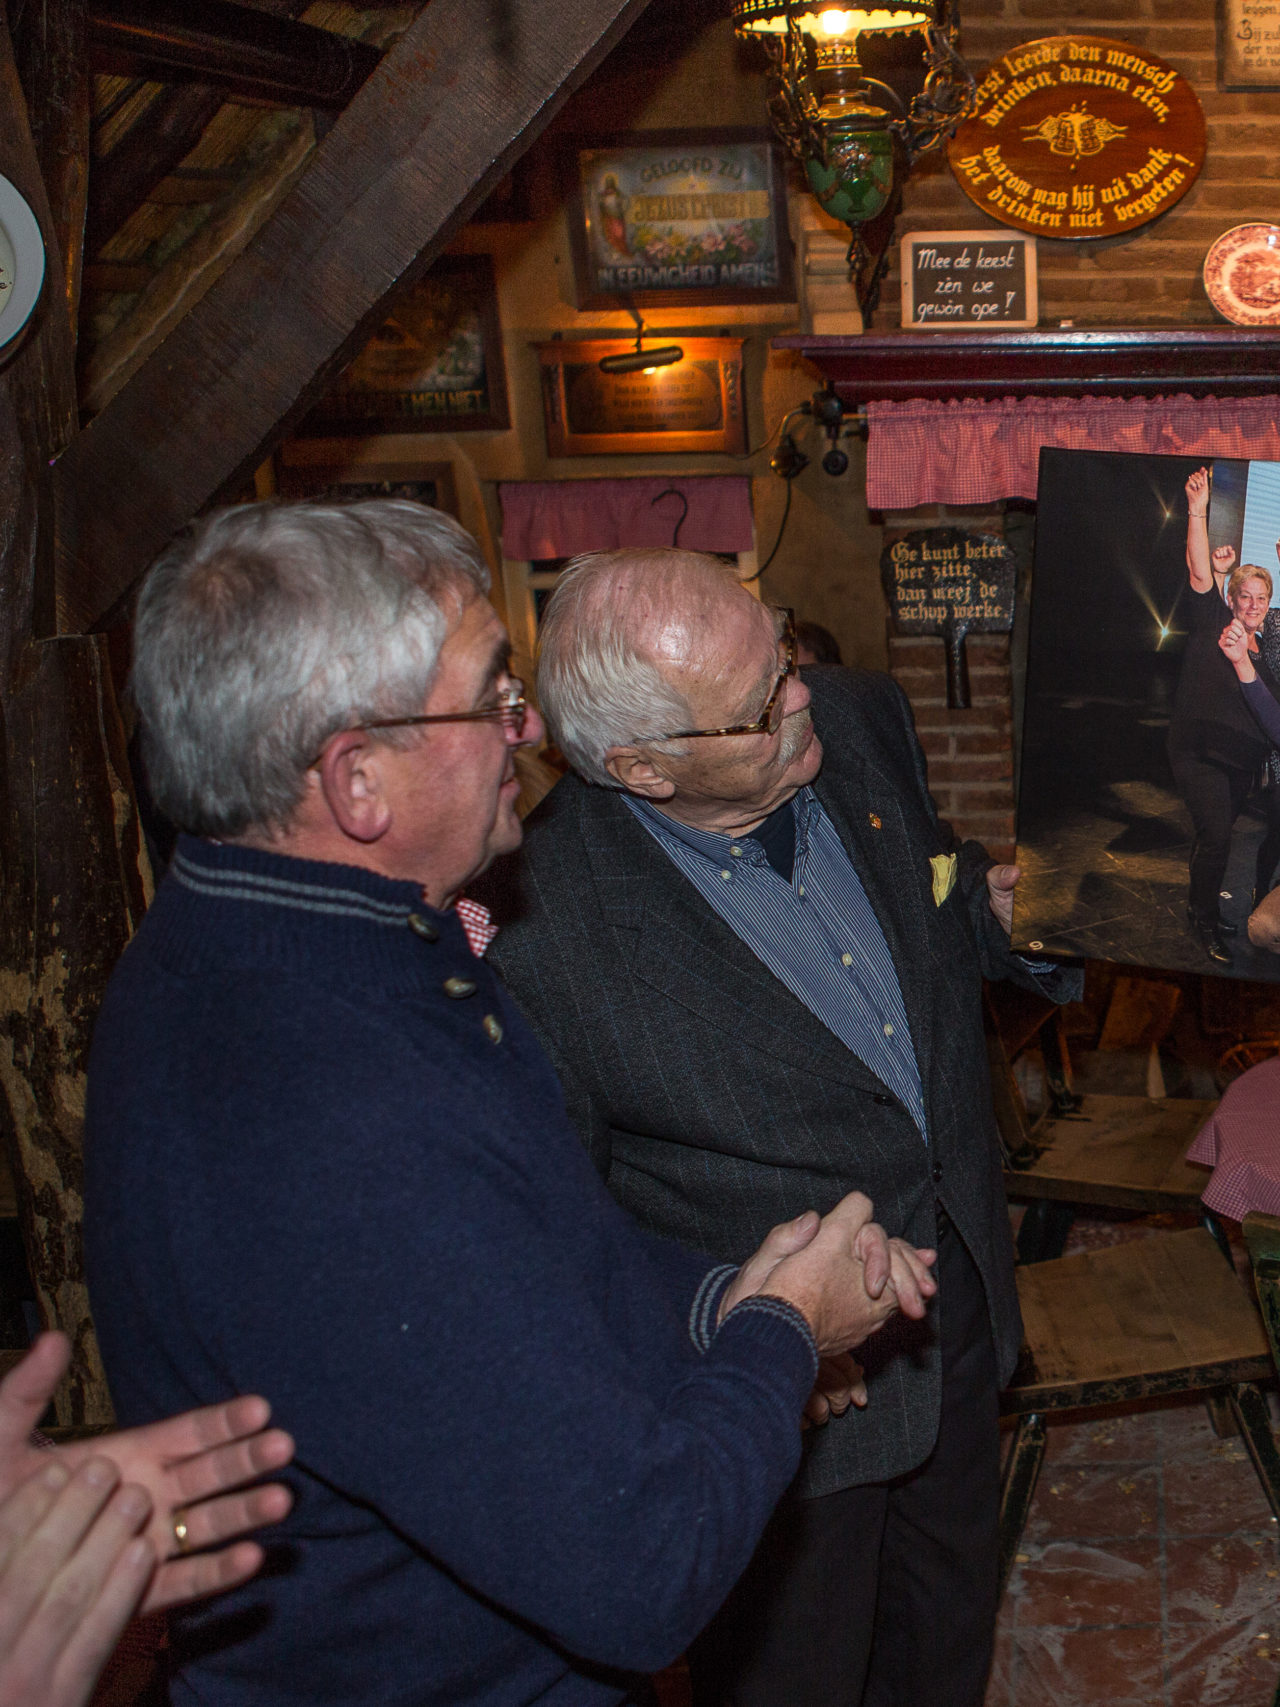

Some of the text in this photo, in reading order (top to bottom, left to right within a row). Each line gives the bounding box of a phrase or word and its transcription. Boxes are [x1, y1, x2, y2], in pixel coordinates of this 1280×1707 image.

[1002, 43, 1061, 77] leerde
[1069, 42, 1102, 62] den
[1105, 49, 1178, 94] mensch
[1059, 63, 1130, 92] daarna
[982, 144, 1173, 211] daarom mag hij uit dank
[957, 154, 993, 186] het
[987, 185, 1063, 227] drinken
[1069, 208, 1104, 228] niet
[917, 247, 951, 269] Mee
[953, 247, 972, 268] de
[972, 281, 994, 293] we
[890, 539, 1006, 562] Ge kunt beter
[894, 562, 925, 583] hier
[896, 585, 926, 601] dan
[980, 580, 998, 598] de
